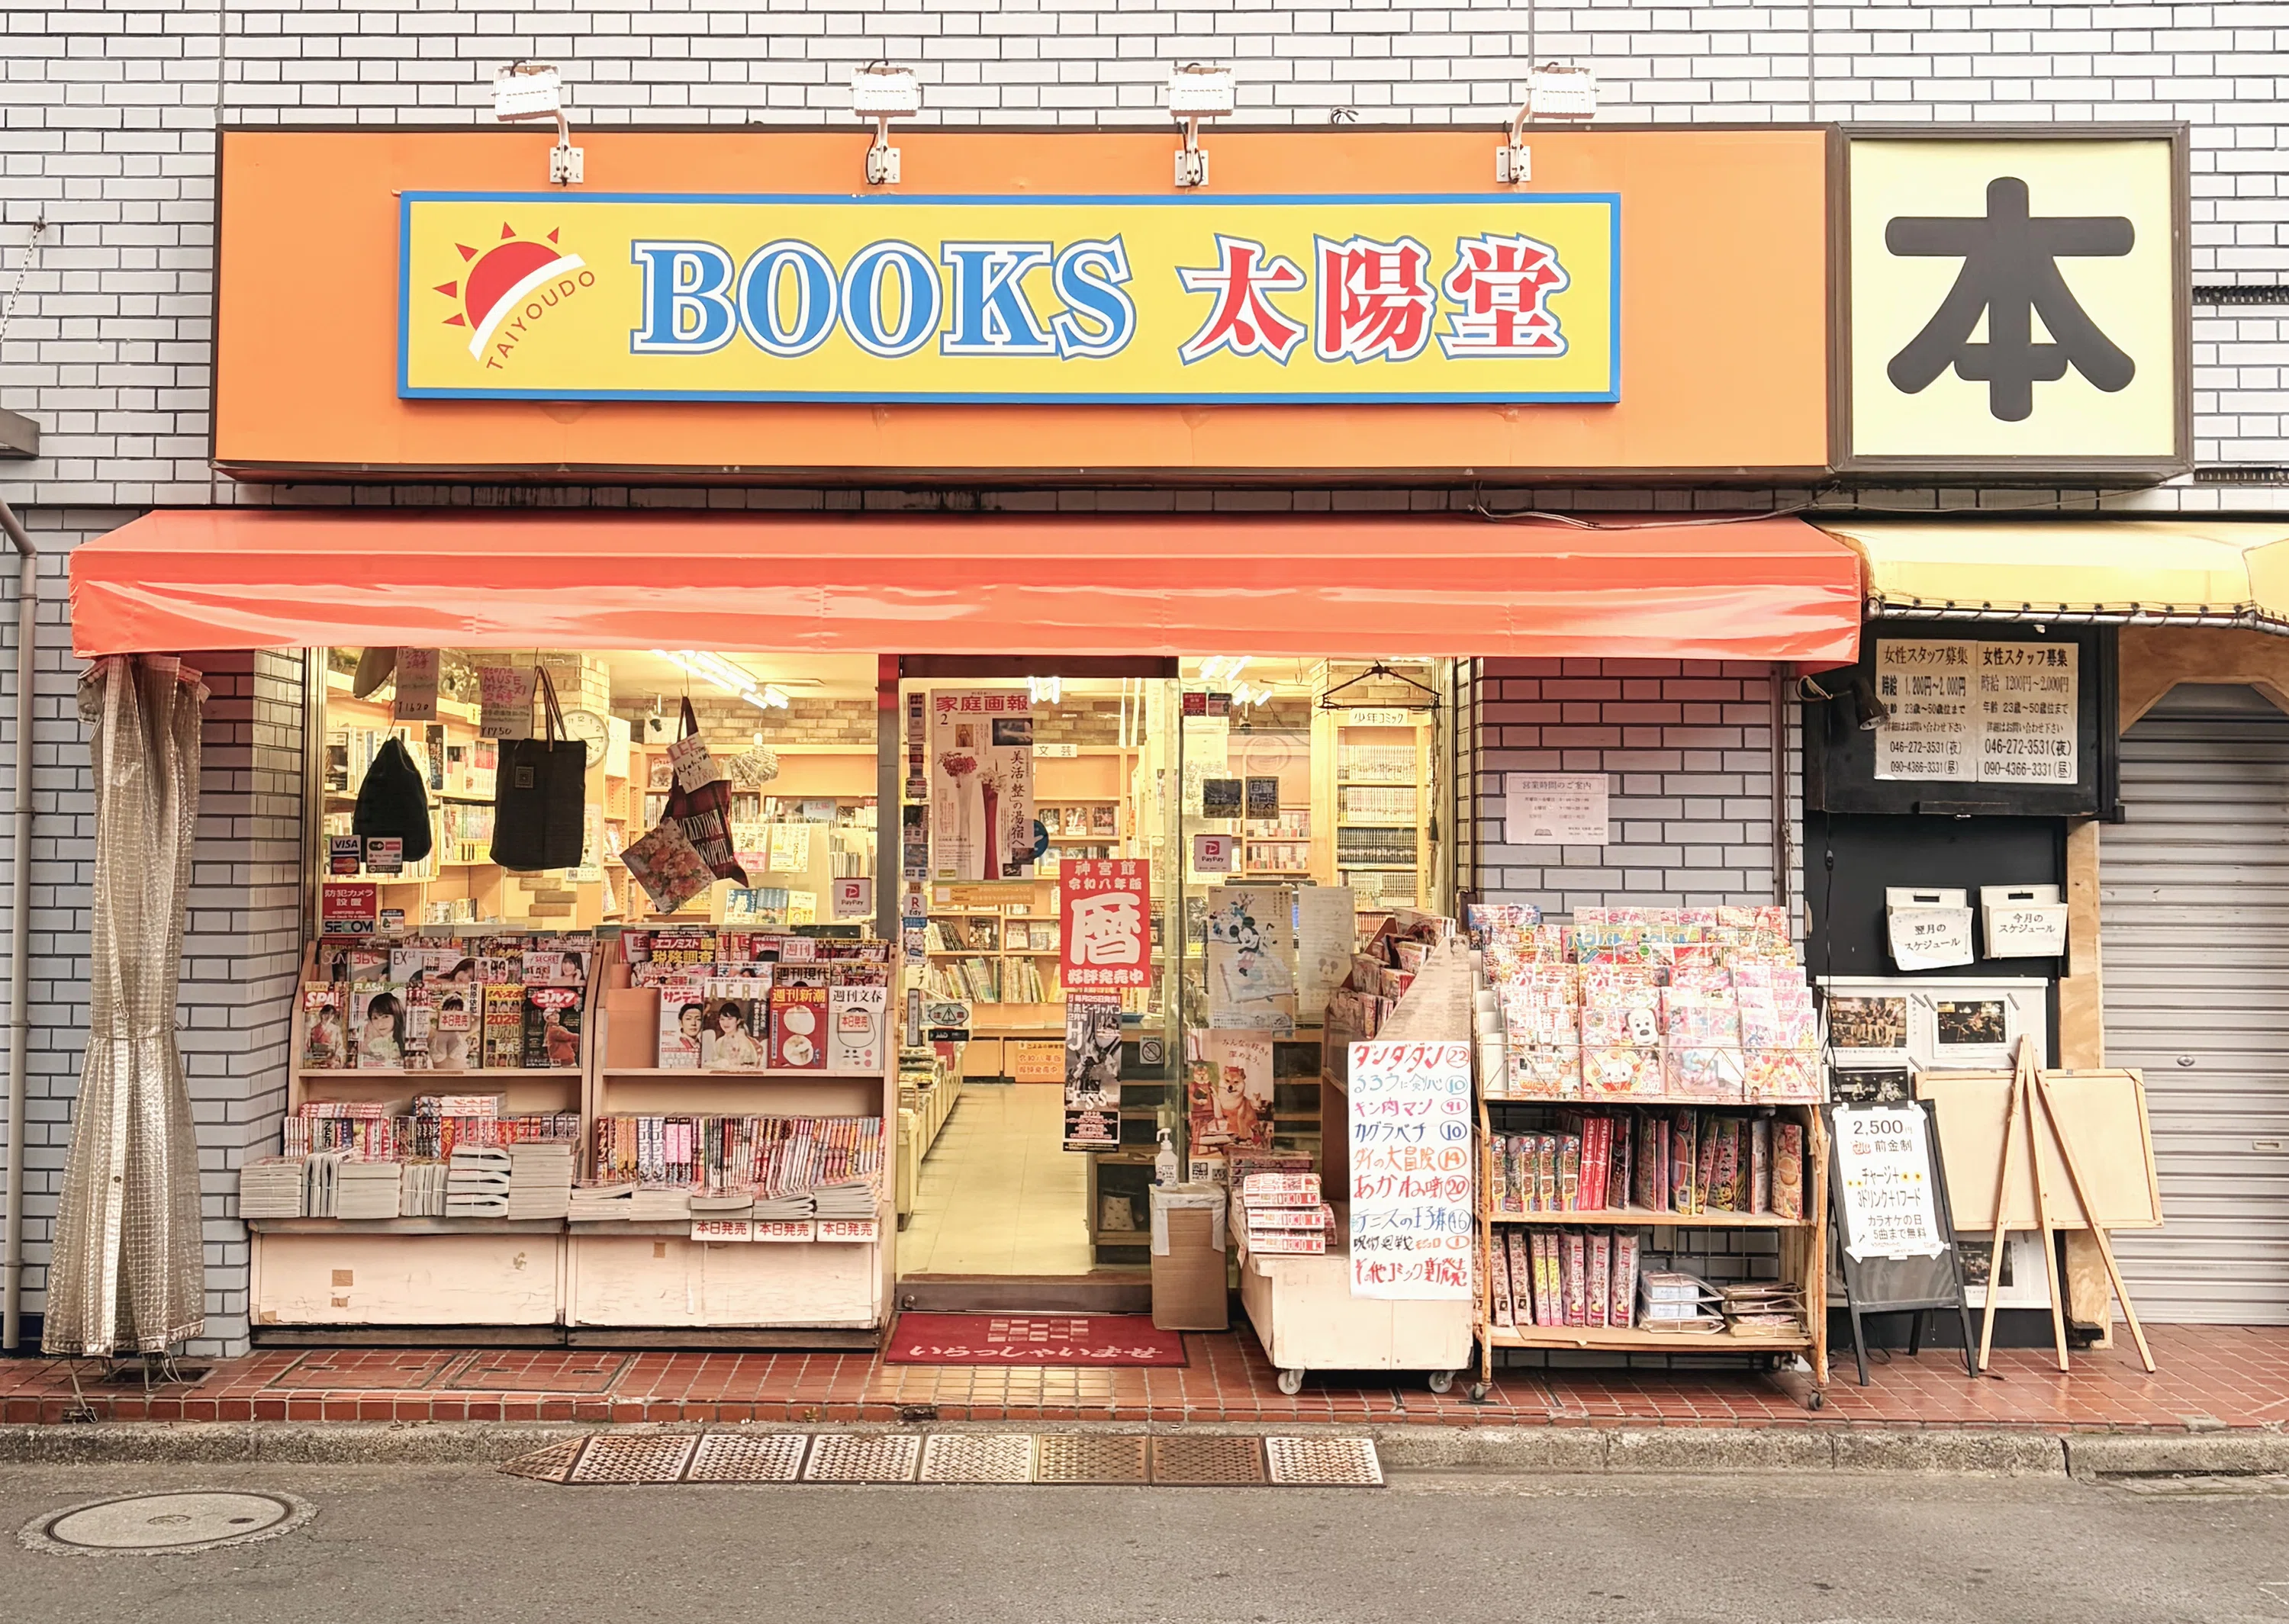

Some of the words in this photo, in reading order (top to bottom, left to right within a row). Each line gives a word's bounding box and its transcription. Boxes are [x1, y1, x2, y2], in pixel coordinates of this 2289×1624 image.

[633, 240, 1134, 358] BOOKS
[1181, 233, 1566, 362] 太陽堂
[1885, 176, 2136, 422] 本
[486, 271, 594, 369] TAIYOUDO
[1884, 645, 1968, 665] 女性スタッフ募集
[1983, 647, 2068, 667] 女性スタッフ募集
[484, 676, 522, 686] MUSE
[936, 695, 1028, 712] 家庭画報
[940, 713, 948, 725] 2
[667, 737, 701, 761] LEE
[335, 840, 358, 848] VISA
[1075, 860, 1135, 876] 神宮館
[1068, 877, 1142, 890] 令和八年版
[336, 898, 362, 906] 設置
[2013, 913, 2043, 923] 今月の
[325, 921, 373, 933] SECOM
[1070, 892, 1141, 965] 暦
[1914, 923, 1946, 935] 翌月の
[1998, 924, 2056, 934] スケジュール
[655, 939, 699, 948] エコノミスト
[1904, 937, 1961, 951] スケジュール
[652, 950, 713, 963] 税務調査
[776, 966, 829, 981] 週刊現代
[1067, 969, 1144, 985] 好評発売中
[354, 982, 385, 991] FLASH
[709, 983, 767, 1001] AERA
[305, 992, 340, 1007] SPA!
[772, 989, 826, 1003] 週刊新潮
[832, 989, 883, 1003] 週刊文春
[487, 1015, 520, 1024] 2026
[1354, 1043, 1444, 1072] ダンダダン
[1354, 1097, 1433, 1118] キン肉マン
[1354, 1121, 1426, 1143] カグラバチ
[1875, 1140, 1912, 1152] 前金制
[697, 1221, 747, 1234] 本日発売
[1868, 1214, 1922, 1227] カラオケの日
[759, 1223, 809, 1236] 本日発売
[823, 1223, 872, 1236] 本日発売
[1874, 1227, 1927, 1240] 5曲まで無料
[909, 1345, 1163, 1359] いらっしゃいませ
